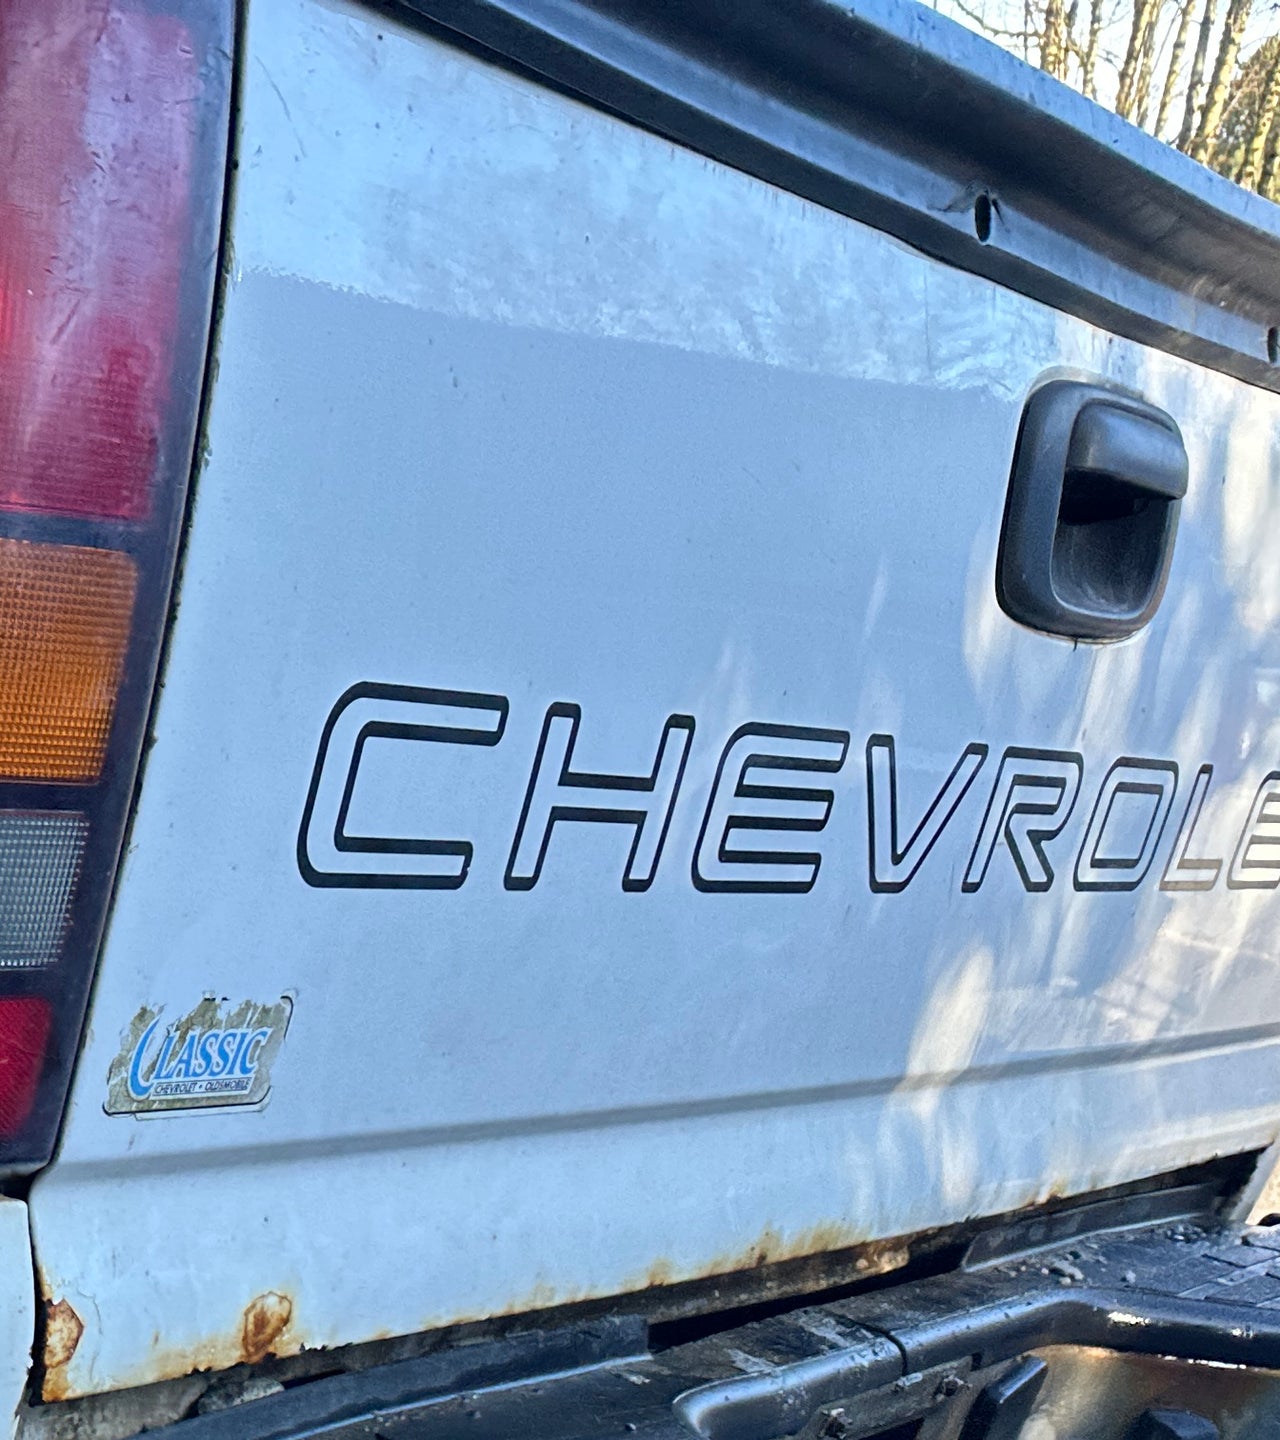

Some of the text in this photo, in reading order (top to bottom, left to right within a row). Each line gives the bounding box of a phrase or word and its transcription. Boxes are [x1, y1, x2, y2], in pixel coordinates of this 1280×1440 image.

[297, 680, 1280, 894] CHEVROLE
[127, 1016, 270, 1099] CLASSIC
[154, 1082, 198, 1095] CHEVROLET
